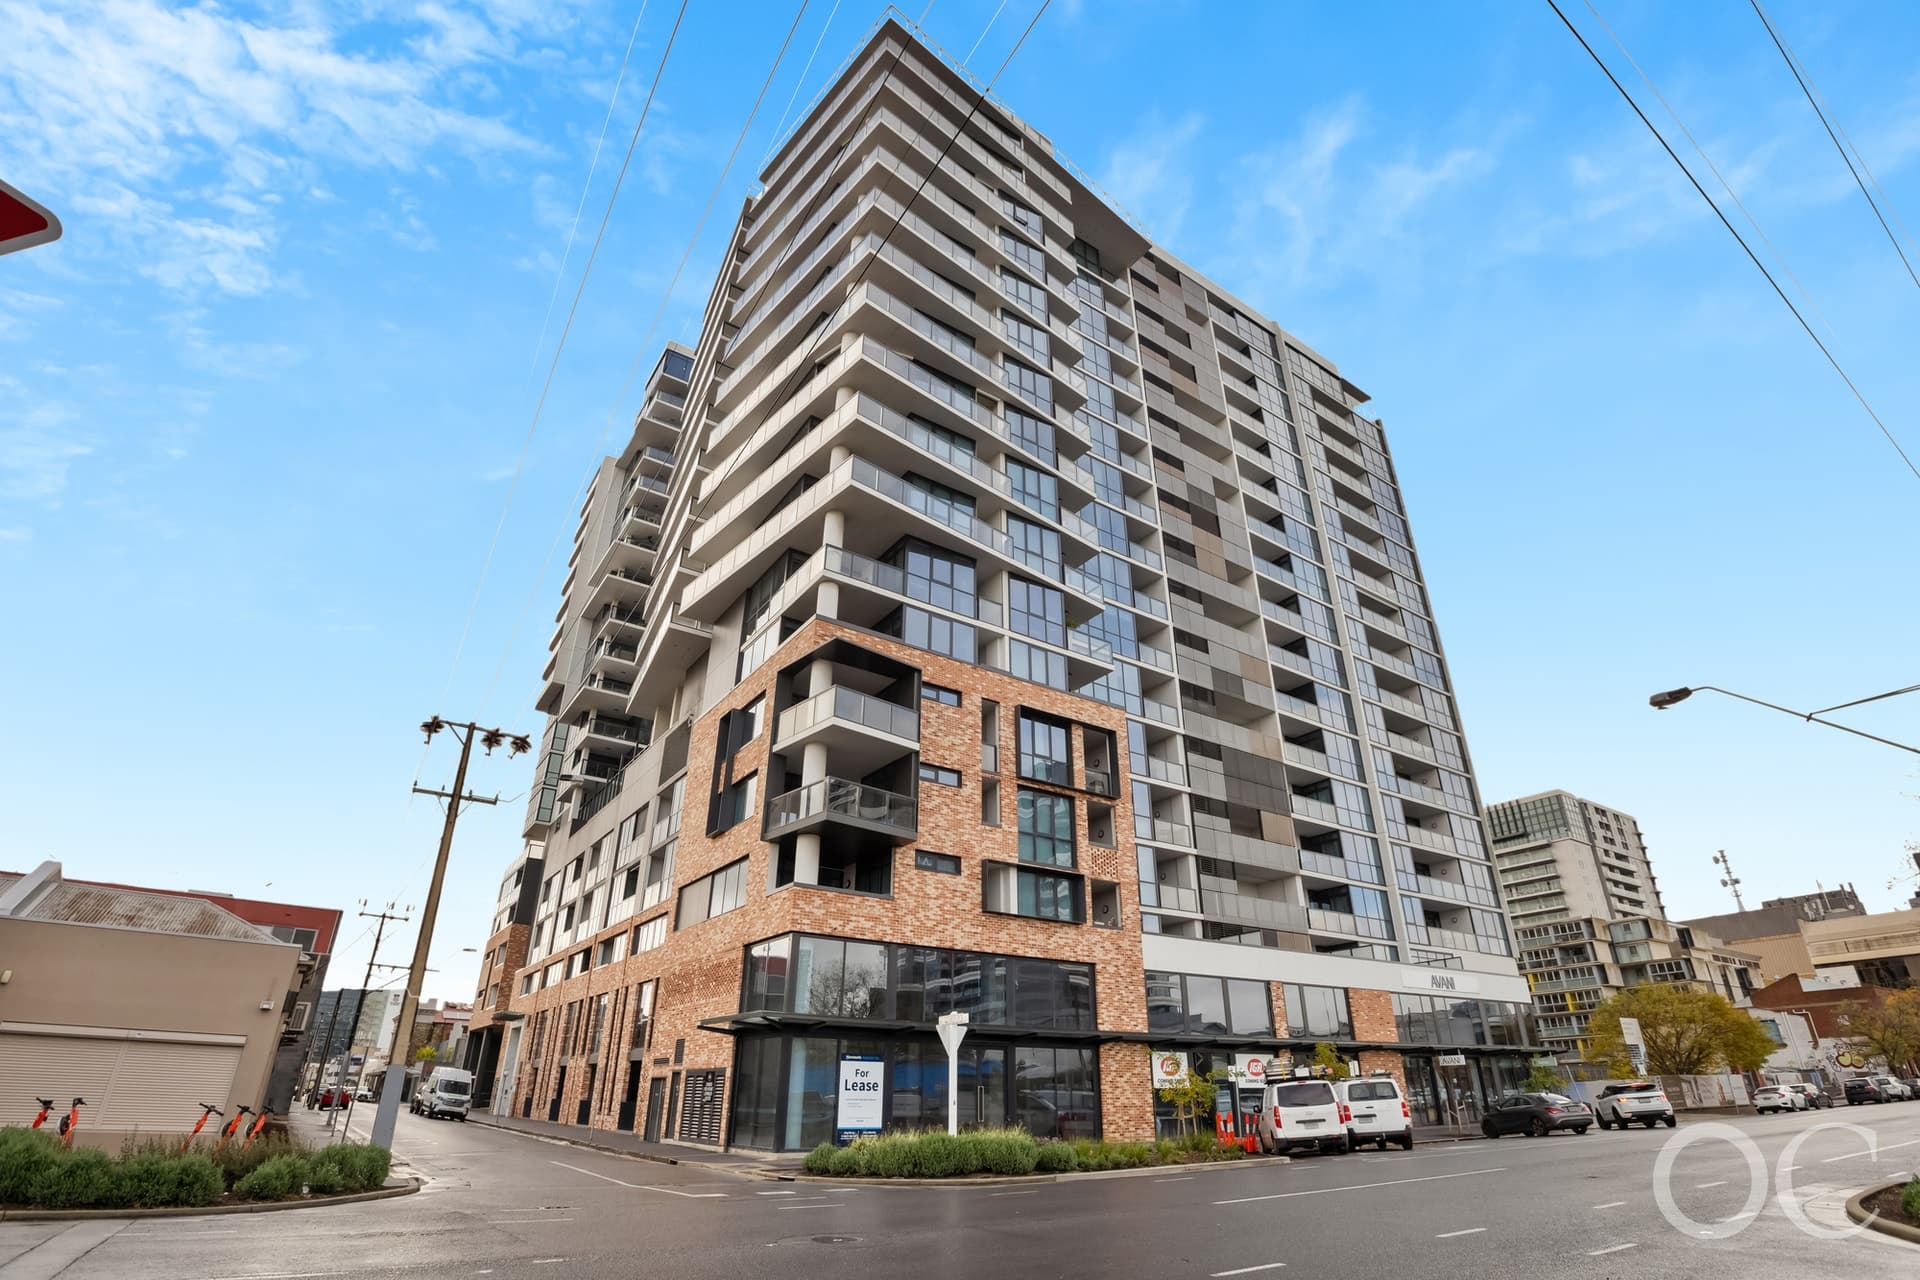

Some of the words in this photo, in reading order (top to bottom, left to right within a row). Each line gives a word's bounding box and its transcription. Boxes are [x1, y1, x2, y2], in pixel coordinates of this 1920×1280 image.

[1431, 974, 1456, 990] AVANI
[855, 1068, 870, 1078] For
[844, 1079, 879, 1092] Lease
